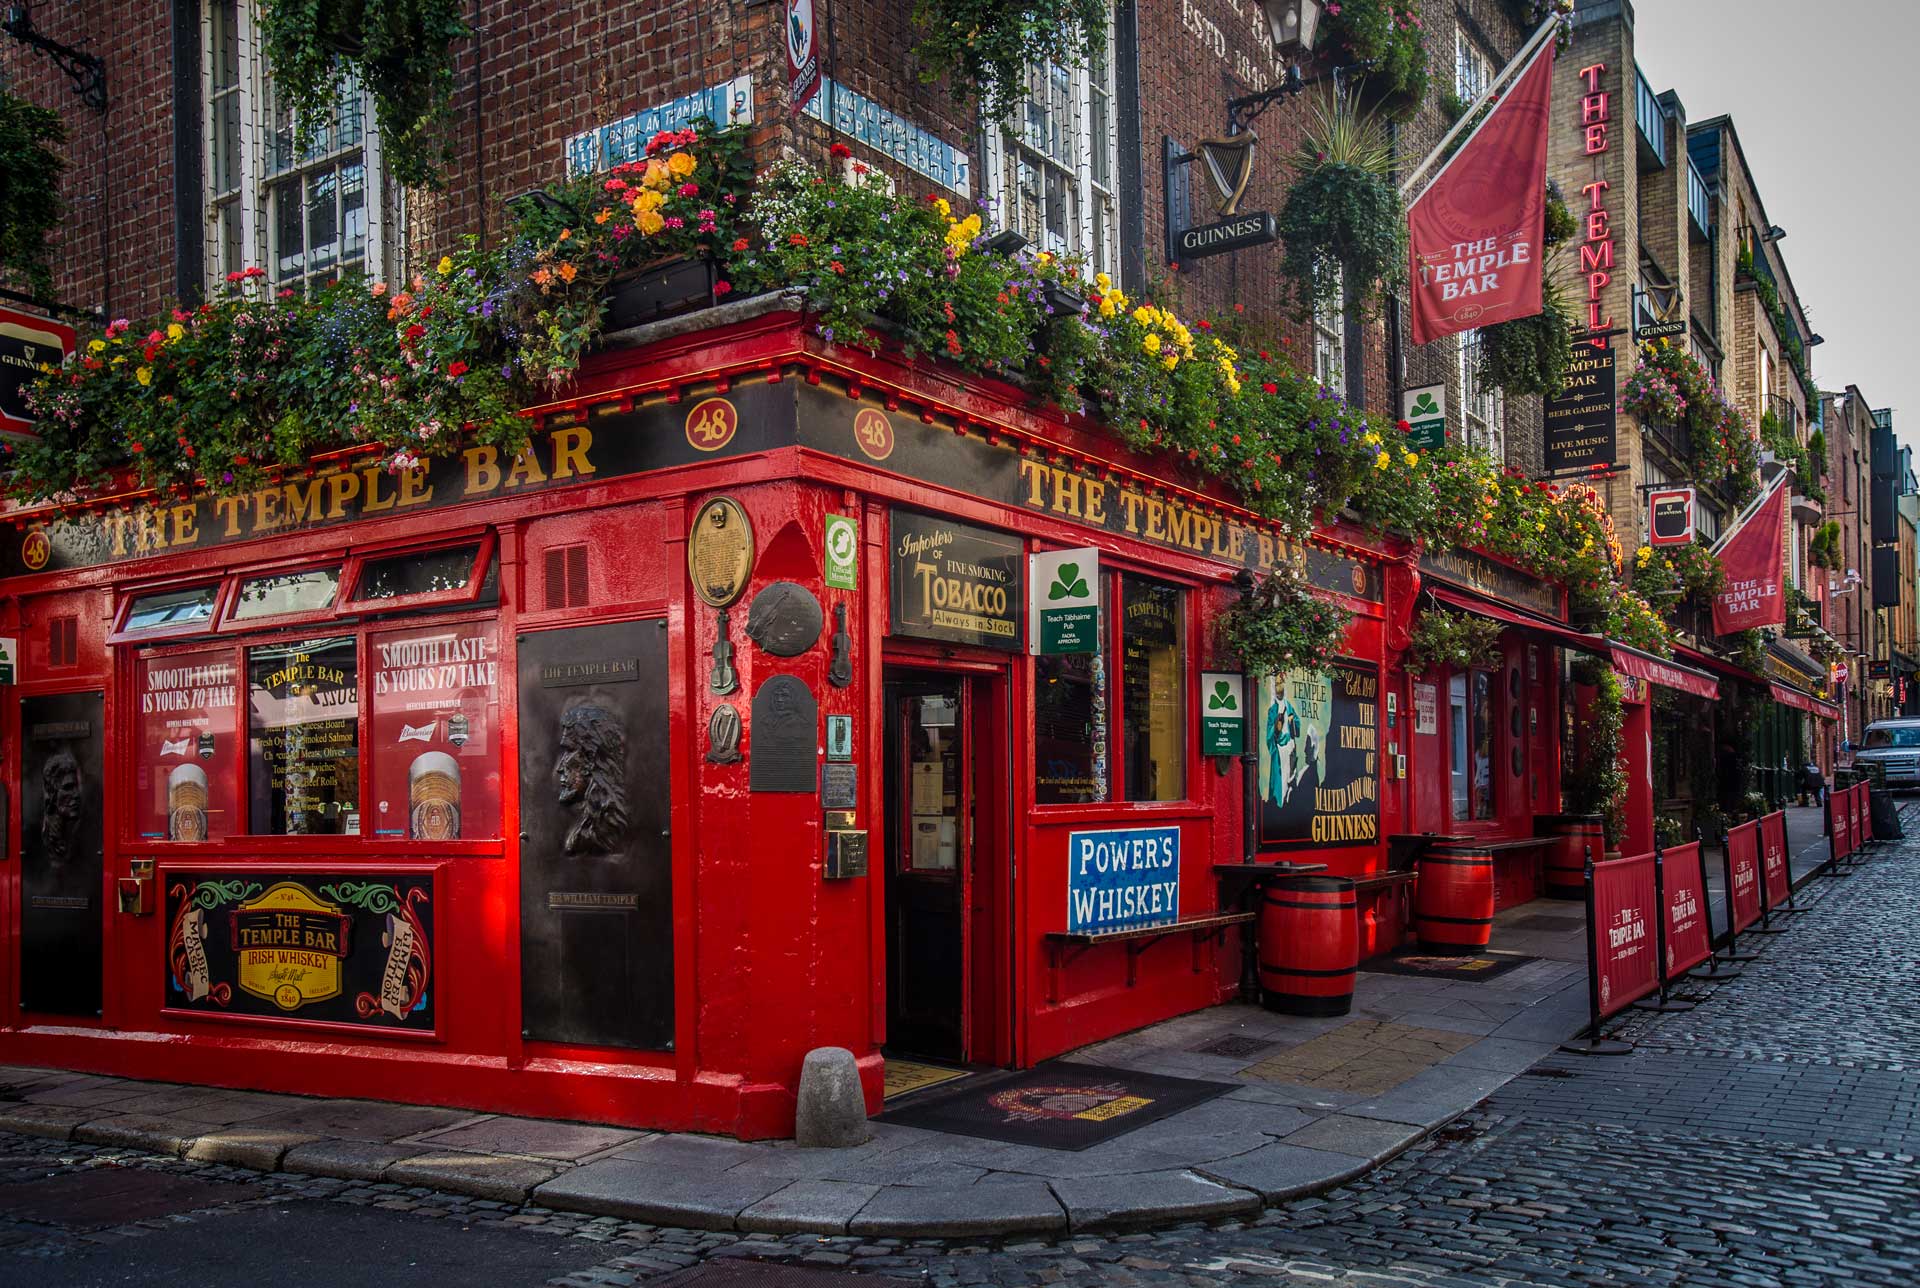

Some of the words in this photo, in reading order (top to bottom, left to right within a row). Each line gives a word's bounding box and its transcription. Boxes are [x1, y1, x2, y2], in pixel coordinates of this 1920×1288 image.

[735, 90, 747, 115] 2
[1579, 63, 1610, 156] THE
[645, 114, 660, 132] AN
[861, 106, 873, 122] AN
[1184, 217, 1262, 248] GUINNESS
[1451, 236, 1497, 259] THE
[1419, 242, 1531, 287] TEMPLE
[1441, 273, 1499, 301] BAR
[1460, 311, 1479, 321] 1840
[1640, 323, 1683, 336] GUINNESS
[1562, 357, 1613, 374] EMPLE
[1563, 375, 1597, 388] BAR
[1549, 406, 1571, 418] BEER
[1572, 403, 1611, 415] GARDEN
[694, 408, 728, 442] 48
[861, 415, 885, 448] 48
[1551, 440, 1574, 450] LIVE
[1576, 436, 1609, 447] MUSIC
[1564, 448, 1595, 459] DAILY
[104, 501, 200, 555] THE
[216, 455, 434, 535] TEMPLE
[463, 426, 597, 496] BAR
[1021, 460, 1107, 524] THE
[1120, 491, 1245, 562] TEMPLE
[26, 537, 47, 567] 48
[898, 530, 953, 560] Importers
[933, 549, 943, 560] OF
[947, 560, 967, 575] FINE
[968, 563, 1006, 582] SMOKING
[914, 562, 1007, 617] TOBACCO
[1731, 580, 1757, 591] THE
[1127, 602, 1160, 618] TEMPLE
[1729, 599, 1760, 614] BAR
[935, 610, 970, 628] Always
[975, 618, 984, 630] in
[986, 620, 1014, 635] Stock
[296, 653, 310, 662] The
[383, 640, 439, 668] SMOOTH
[443, 637, 487, 662] TASTE
[148, 667, 192, 691] SMOOTH
[195, 664, 229, 686] TASTE
[264, 665, 314, 690] TEMPLE
[318, 666, 344, 685] BAR
[376, 672, 388, 693] IS
[391, 667, 435, 692] YOURS
[439, 666, 456, 688] TO
[460, 662, 495, 687] TAKE
[544, 667, 560, 678] THE
[568, 663, 609, 677] TEMPLE
[612, 659, 635, 673] BAR
[1836, 669, 1848, 677] STOP
[143, 693, 153, 713] IS
[155, 690, 189, 712] YOURS
[191, 688, 205, 709] TO
[208, 686, 236, 707] TAKE
[1293, 681, 1327, 702] TEMPLE
[1301, 701, 1319, 720] BAR
[1358, 703, 1375, 726] THE
[326, 719, 345, 728] Board
[402, 728, 432, 737] Budweiser
[329, 732, 353, 741] Salmon
[1340, 726, 1375, 750] EMPEROR
[1366, 752, 1375, 774] OF
[272, 779, 283, 788] Hot
[304, 777, 319, 787] Beef
[321, 777, 338, 786] Rolls
[1315, 787, 1346, 812] MALTED
[1347, 776, 1376, 807] LIQUORS
[1312, 814, 1376, 842] GUINNESS
[1080, 837, 1173, 875] POWER'S
[562, 894, 600, 904] WILLIAM
[601, 895, 636, 905] TEMPLE
[1073, 882, 1177, 924] WHISKEY
[1688, 898, 1697, 916] BAR
[275, 913, 301, 928] THE
[1621, 909, 1631, 924] THE
[240, 928, 301, 945] TEMPLE
[305, 930, 337, 950] BAR
[1609, 924, 1632, 948] TEMPLE
[1633, 919, 1645, 941] BAR
[185, 936, 199, 974] CASK
[190, 921, 208, 984] MALBEC
[248, 950, 274, 965] IRISH
[278, 951, 329, 970] WHISKEY
[383, 936, 402, 1000] EDITION
[391, 932, 411, 1006] LIMITED
